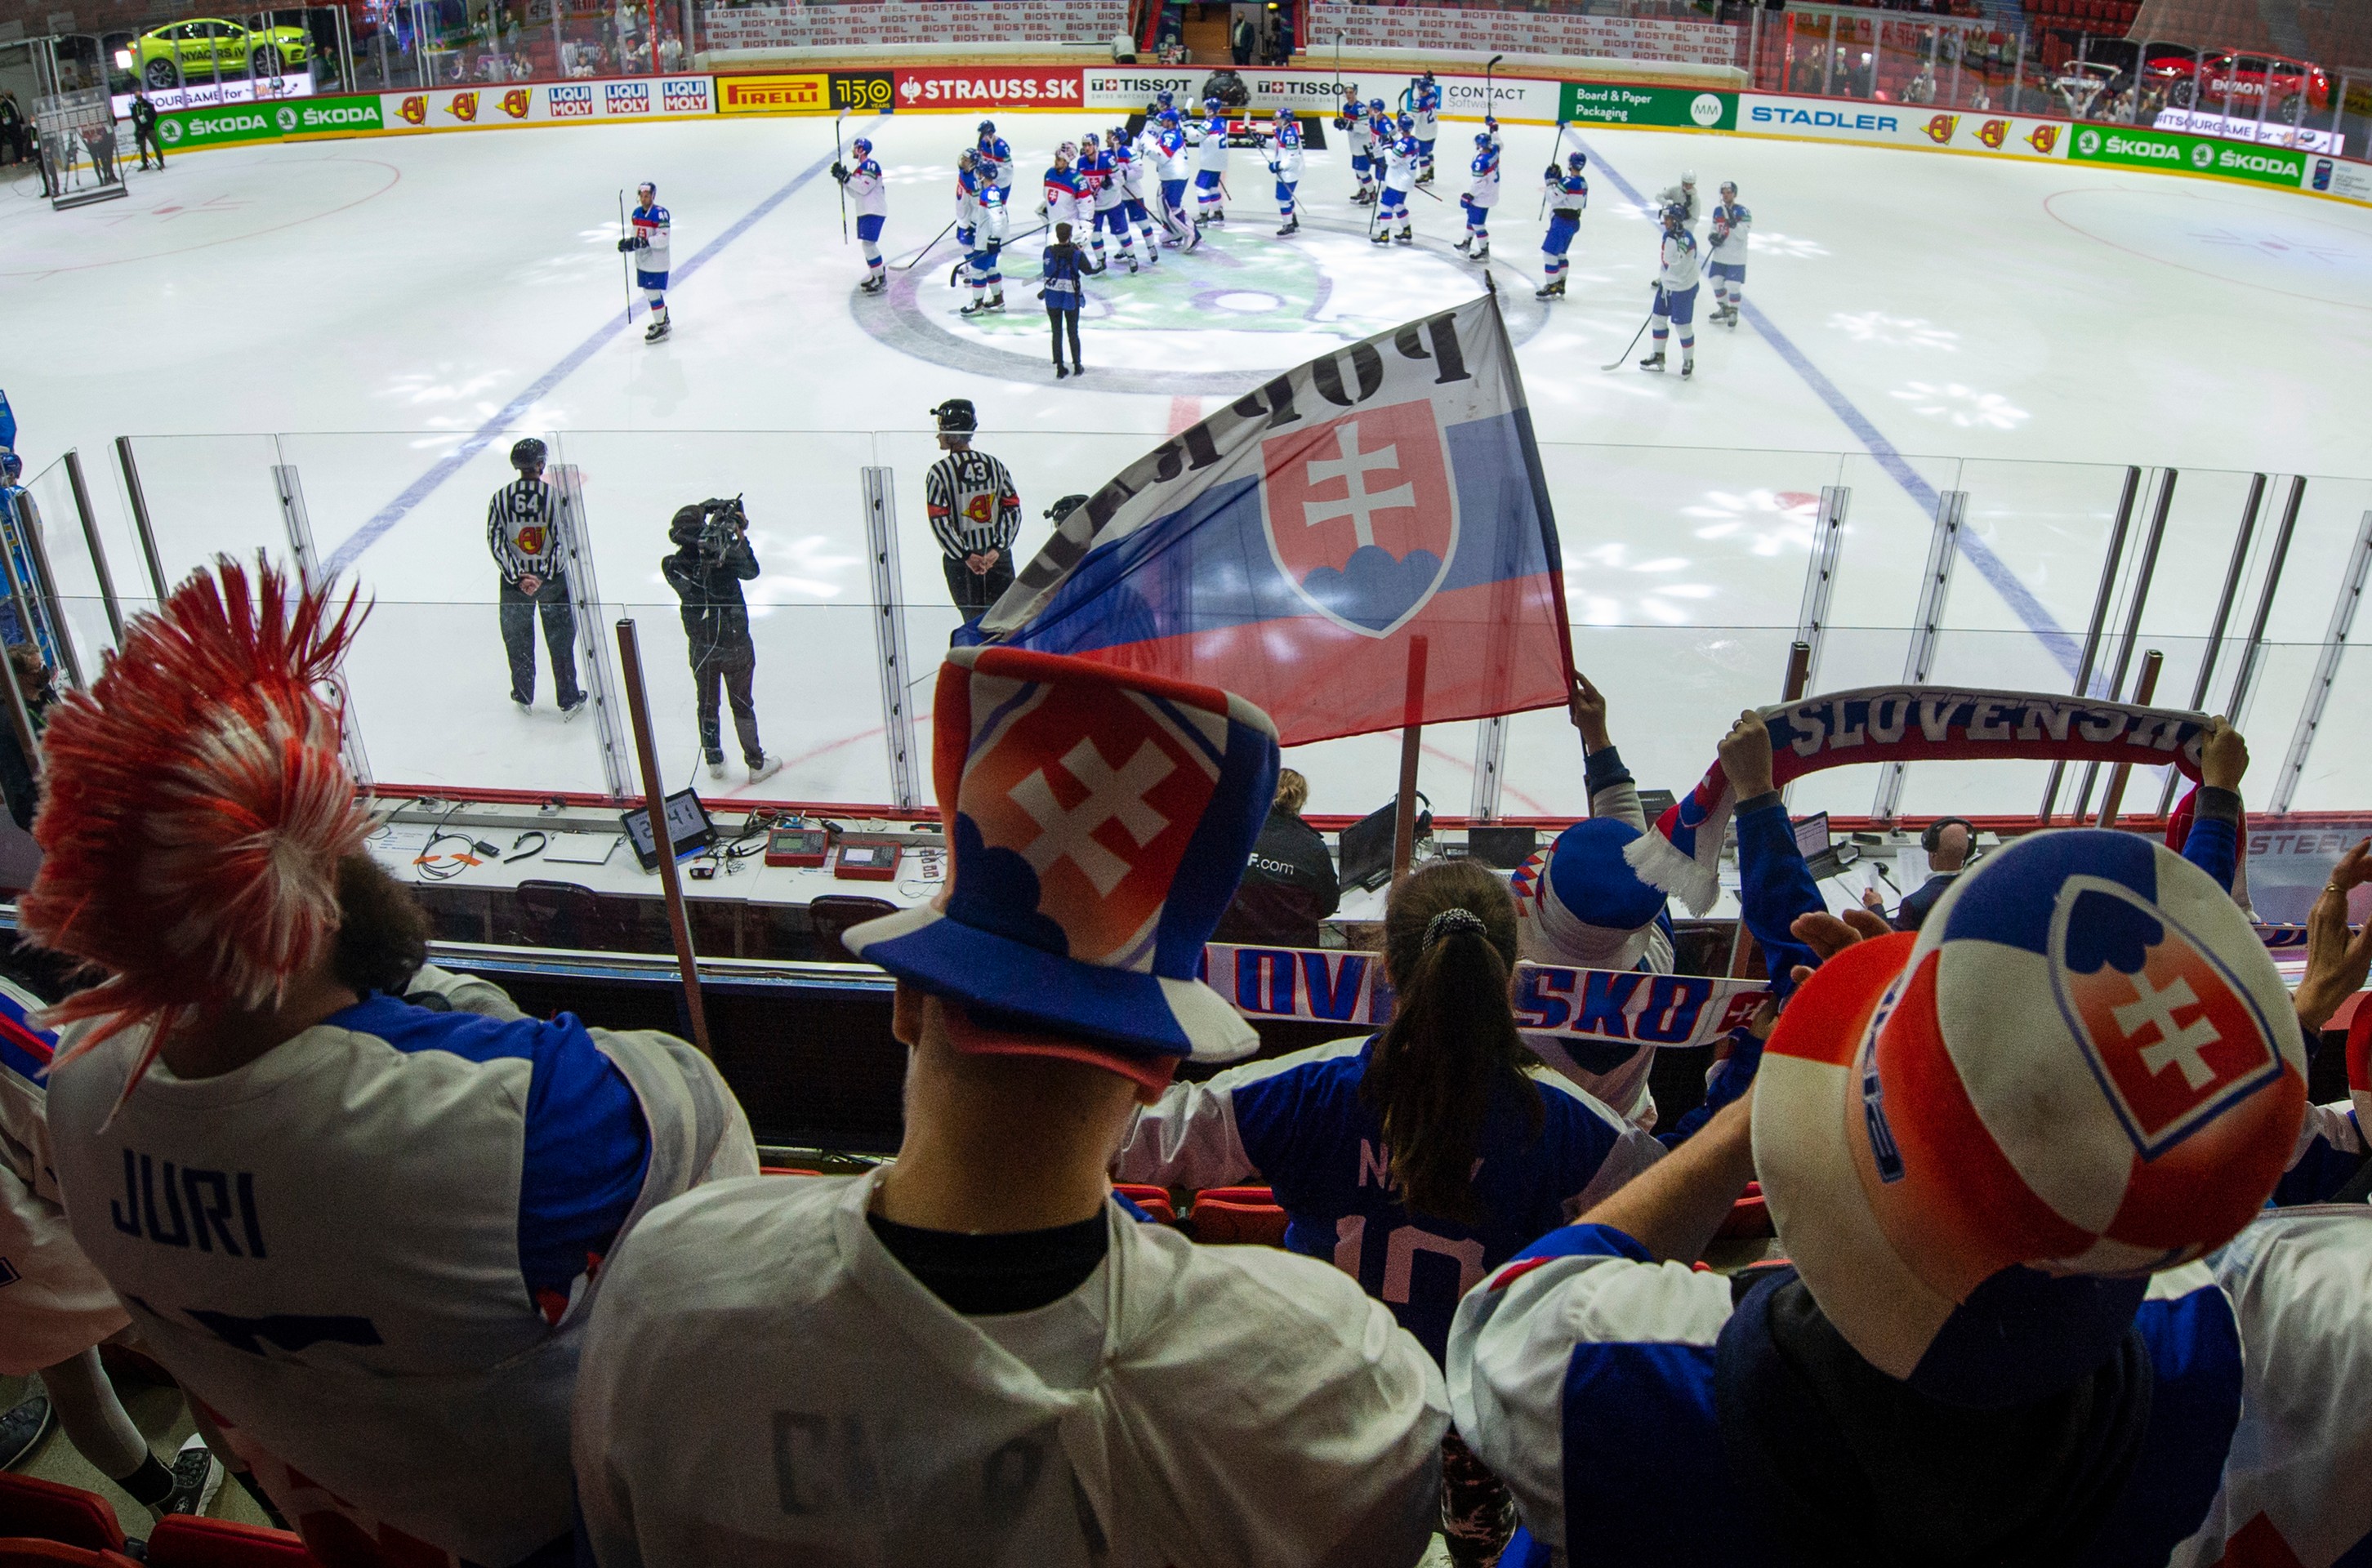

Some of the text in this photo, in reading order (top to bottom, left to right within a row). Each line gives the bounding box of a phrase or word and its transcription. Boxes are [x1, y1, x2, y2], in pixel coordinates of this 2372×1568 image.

[606, 83, 648, 98] LIQUI
[663, 81, 706, 96] LIQUI
[925, 79, 1078, 99] STRAUSS.SK
[1120, 79, 1192, 91] TISSOT
[1286, 81, 1346, 96] TISSO
[225, 89, 243, 99] for
[550, 87, 591, 101] LIQUI
[727, 82, 818, 105] PIRELLI
[836, 79, 891, 109] 150
[1448, 86, 1526, 100] CONTACT
[1577, 88, 1652, 106] Board & Paper
[551, 101, 592, 115] MOLY
[607, 98, 649, 113] MOLY
[664, 96, 707, 110] MOLY
[1448, 97, 1498, 109] Software
[1694, 105, 1719, 116] MM
[304, 107, 380, 125] ŠKODA
[1576, 105, 1629, 122] Packaging
[1751, 106, 1898, 132] STADLER
[189, 115, 268, 136] ŠKODA
[1285, 135, 1296, 144] 72
[2106, 136, 2181, 161] ŠKODA
[866, 161, 876, 172] 14
[2219, 149, 2299, 177] ŠKODA
[965, 461, 988, 482] 43
[514, 492, 539, 514] 64
[111, 1148, 267, 1259] JURI
